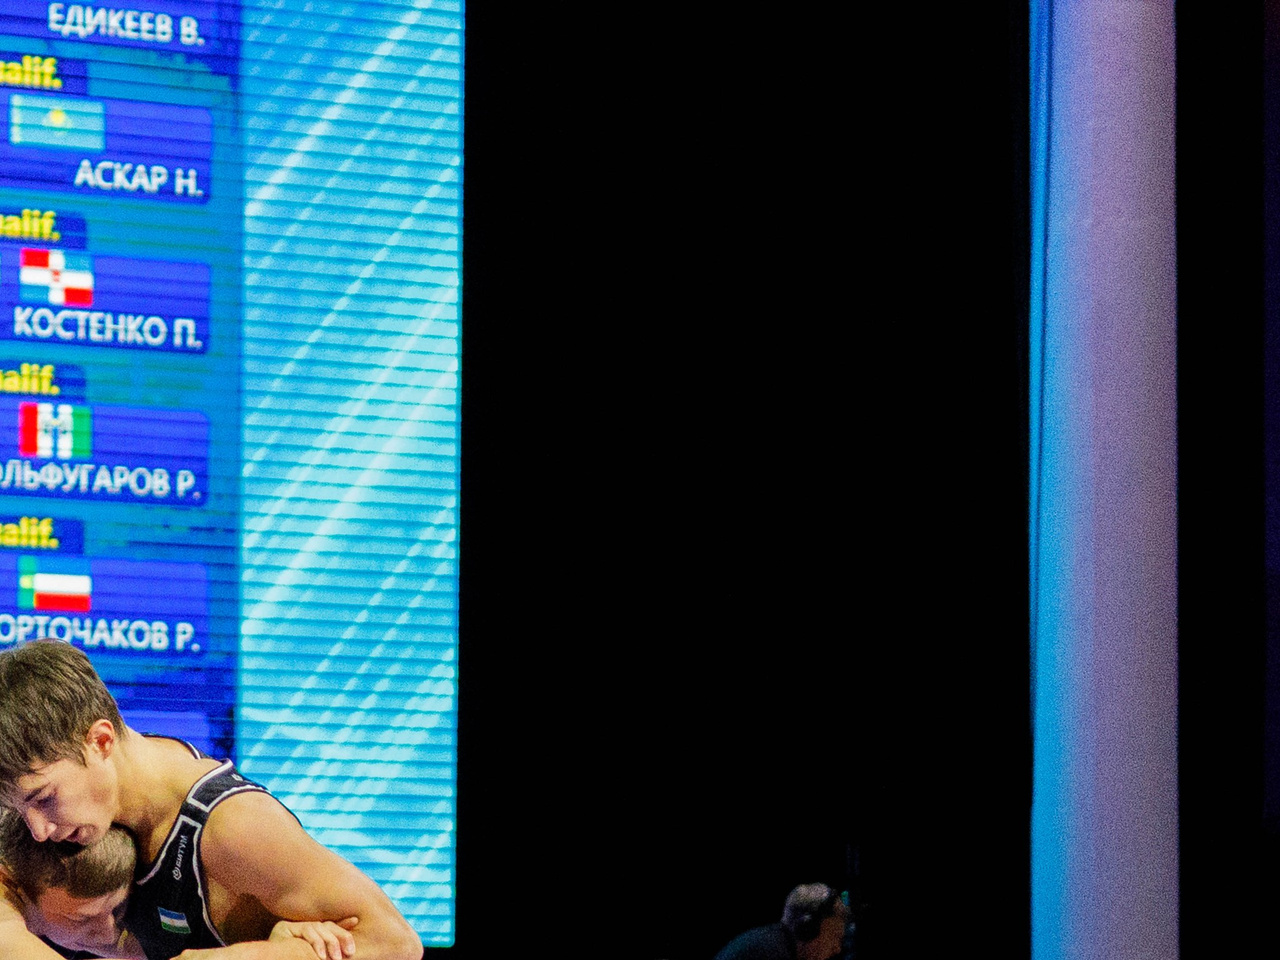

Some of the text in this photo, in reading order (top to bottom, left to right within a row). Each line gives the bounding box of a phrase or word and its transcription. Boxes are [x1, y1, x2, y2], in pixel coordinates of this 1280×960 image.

[48, 3, 205, 46] ЕДИКЕЕВ В.
[74, 159, 204, 197] АСКАР Н.
[14, 307, 203, 349] КОСТЕНКО П.
[176, 470, 200, 500] Р.
[175, 622, 200, 651] Р.
